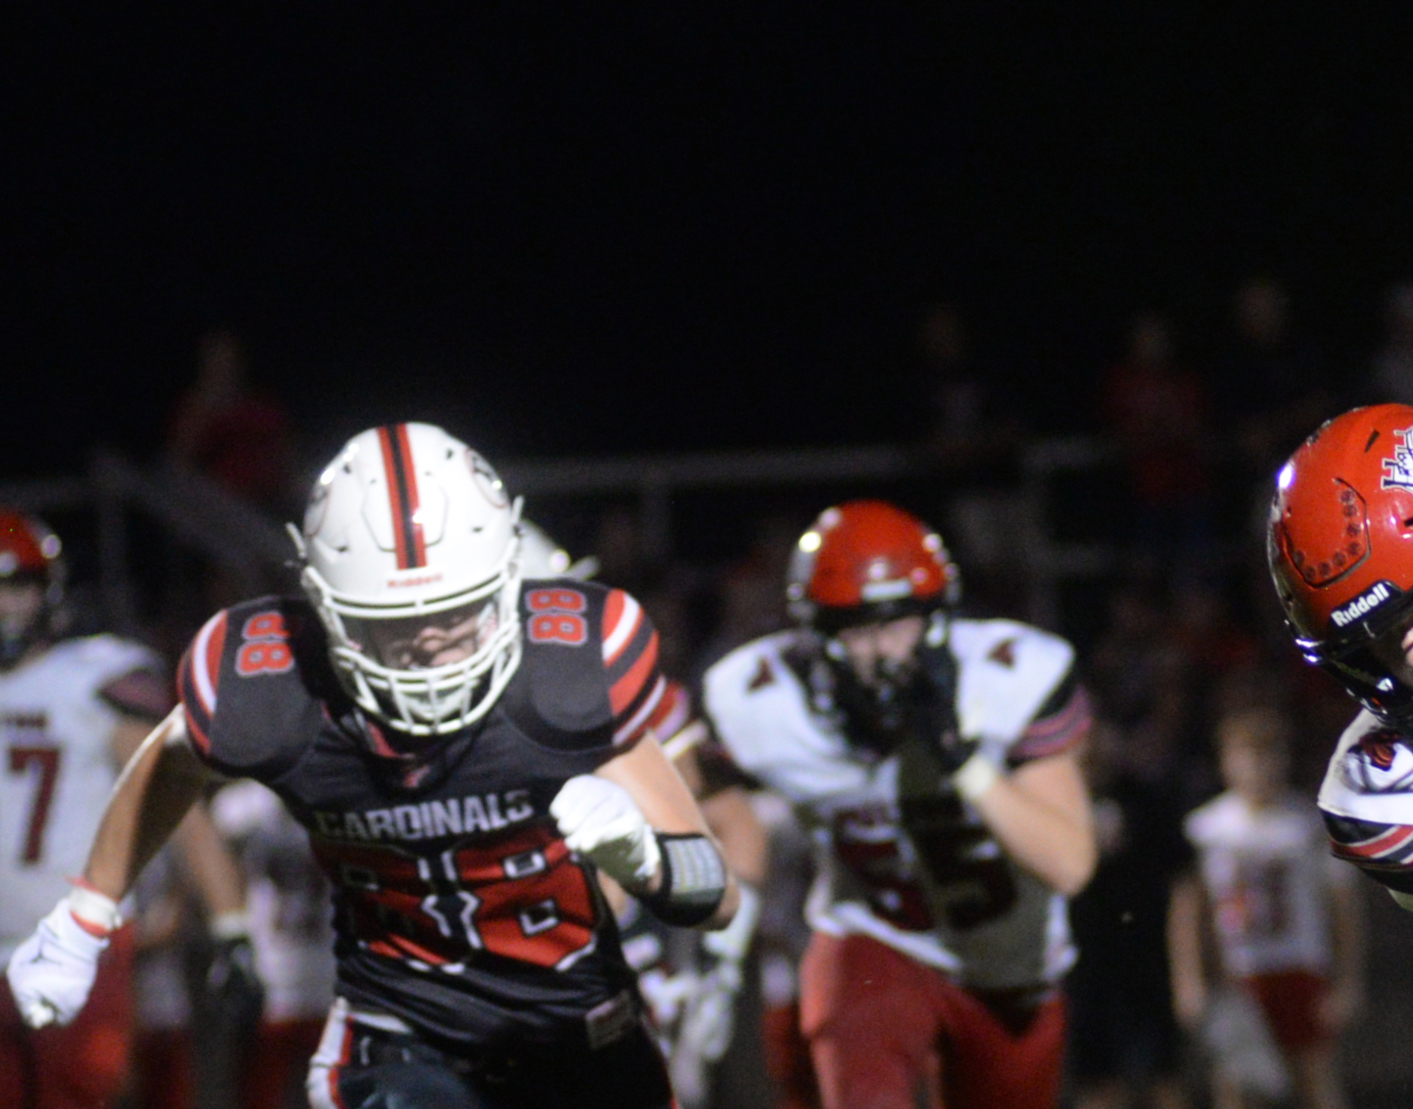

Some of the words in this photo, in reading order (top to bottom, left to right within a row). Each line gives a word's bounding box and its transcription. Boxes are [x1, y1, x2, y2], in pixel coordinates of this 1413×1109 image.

[525, 588, 588, 647] 88
[1331, 583, 1390, 628] Riddell
[235, 609, 296, 677] 88
[8, 743, 62, 867] 7
[314, 789, 534, 840] CARDINALS
